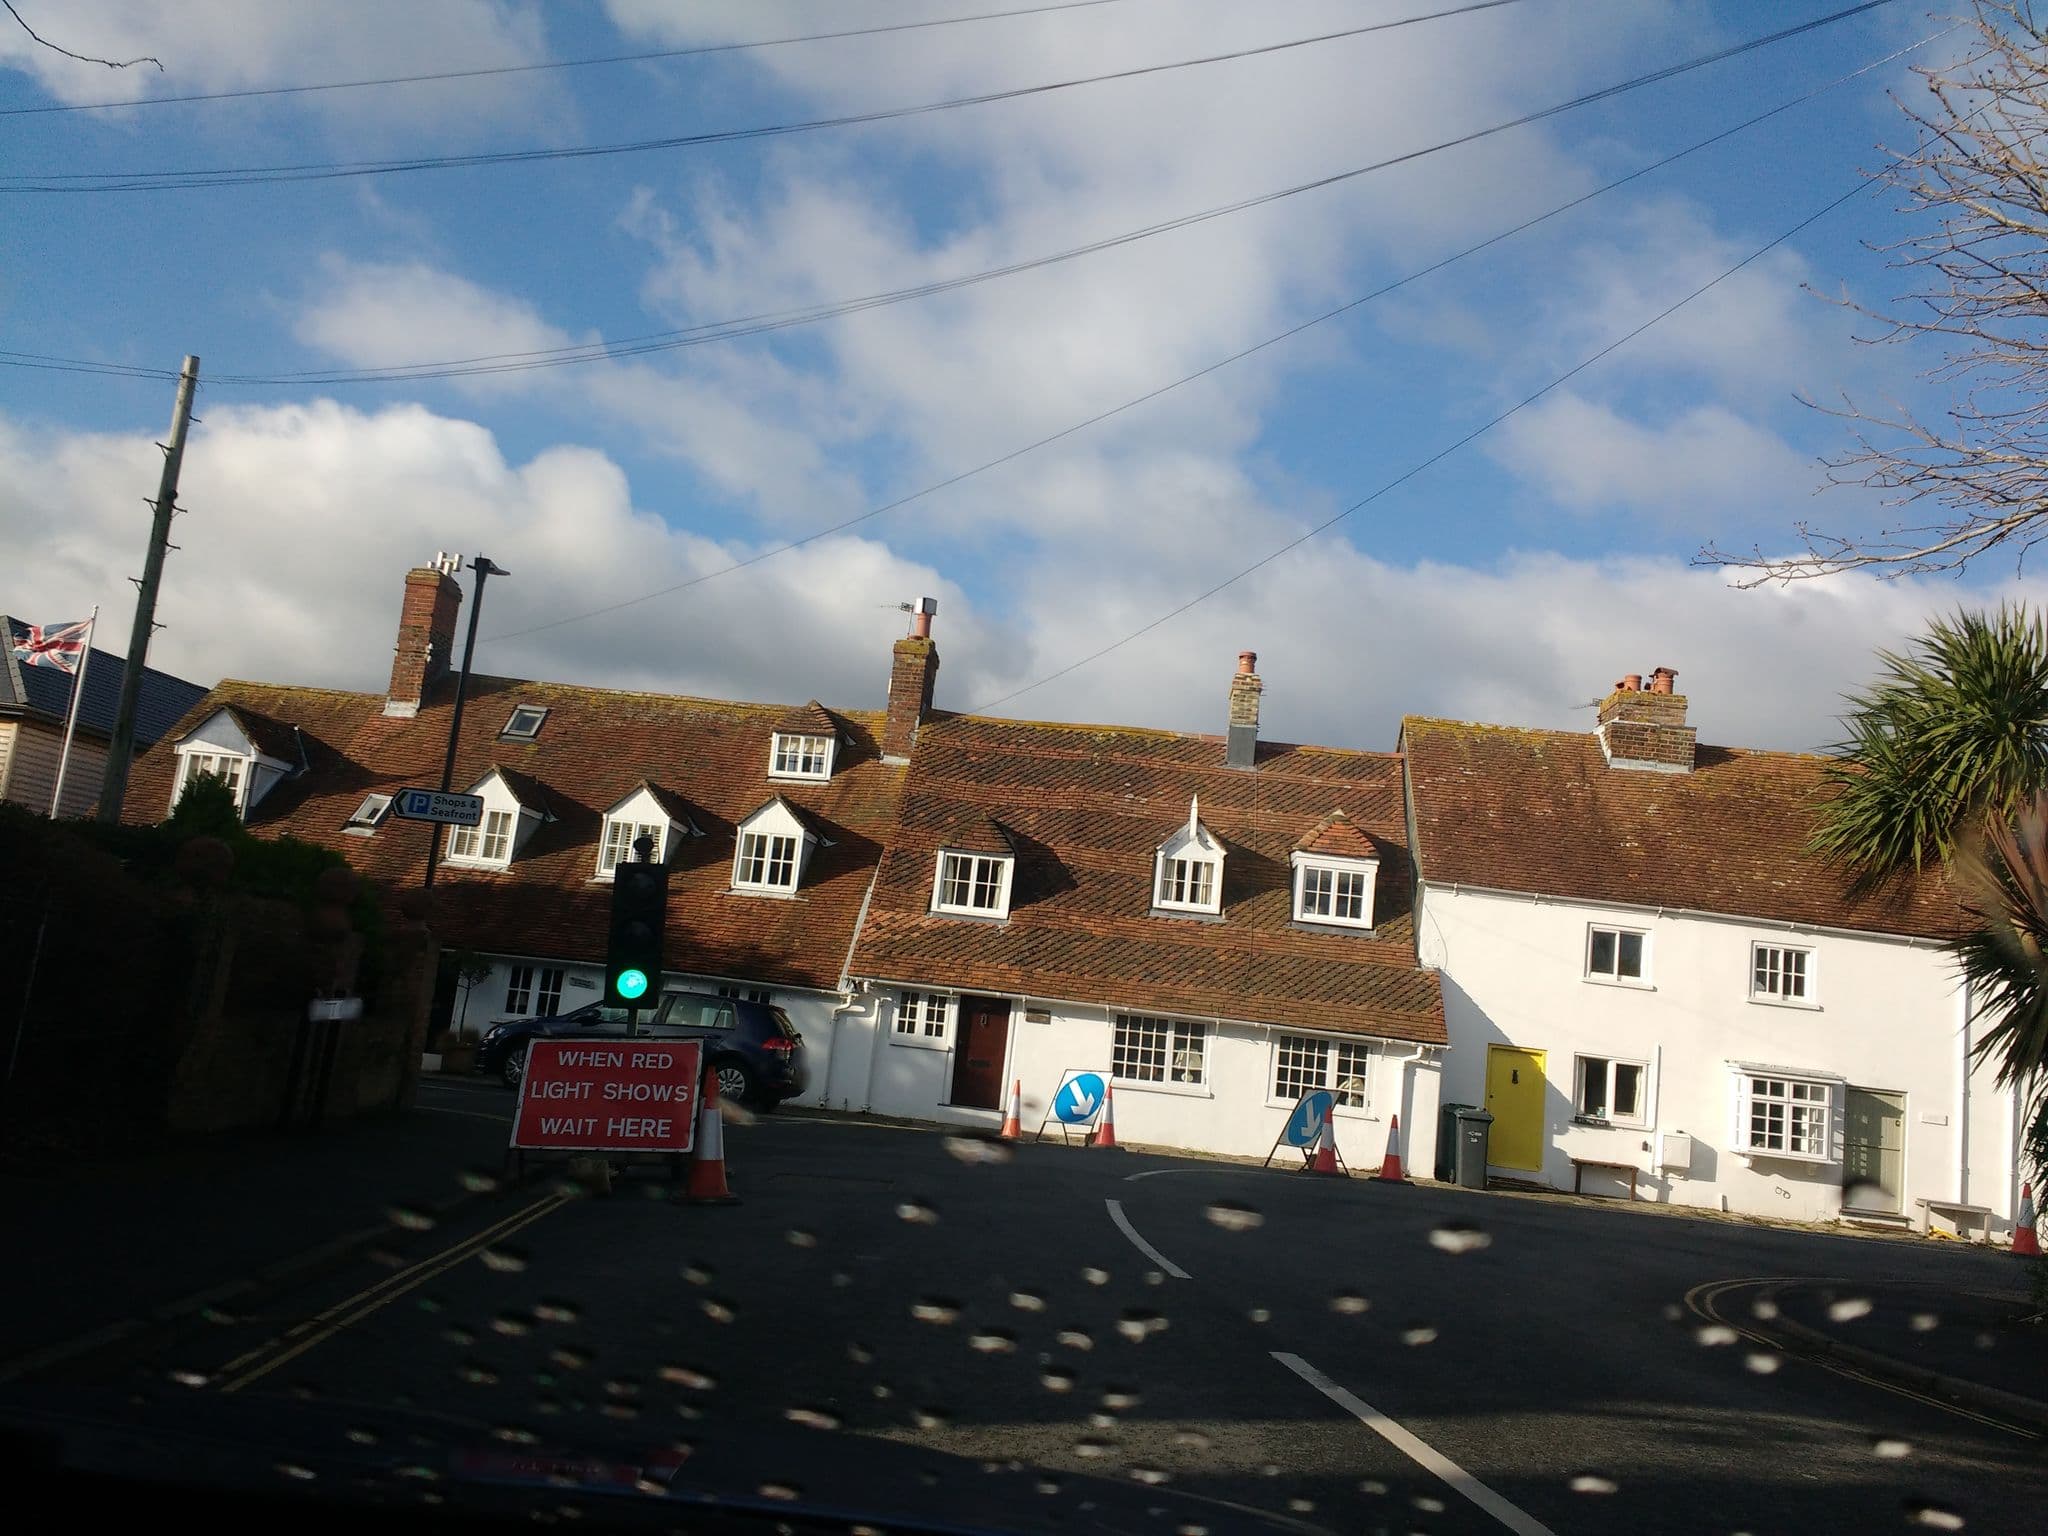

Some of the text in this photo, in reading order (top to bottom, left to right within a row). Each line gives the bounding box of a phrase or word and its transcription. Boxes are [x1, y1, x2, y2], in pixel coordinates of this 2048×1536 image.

[413, 795, 426, 811] P
[434, 796, 478, 809] Shops &
[430, 807, 477, 820] Seafront
[558, 1051, 674, 1069] WHEN RED
[530, 1081, 690, 1102] LIGHT SHOWS
[540, 1117, 673, 1139] WAIT HERE
